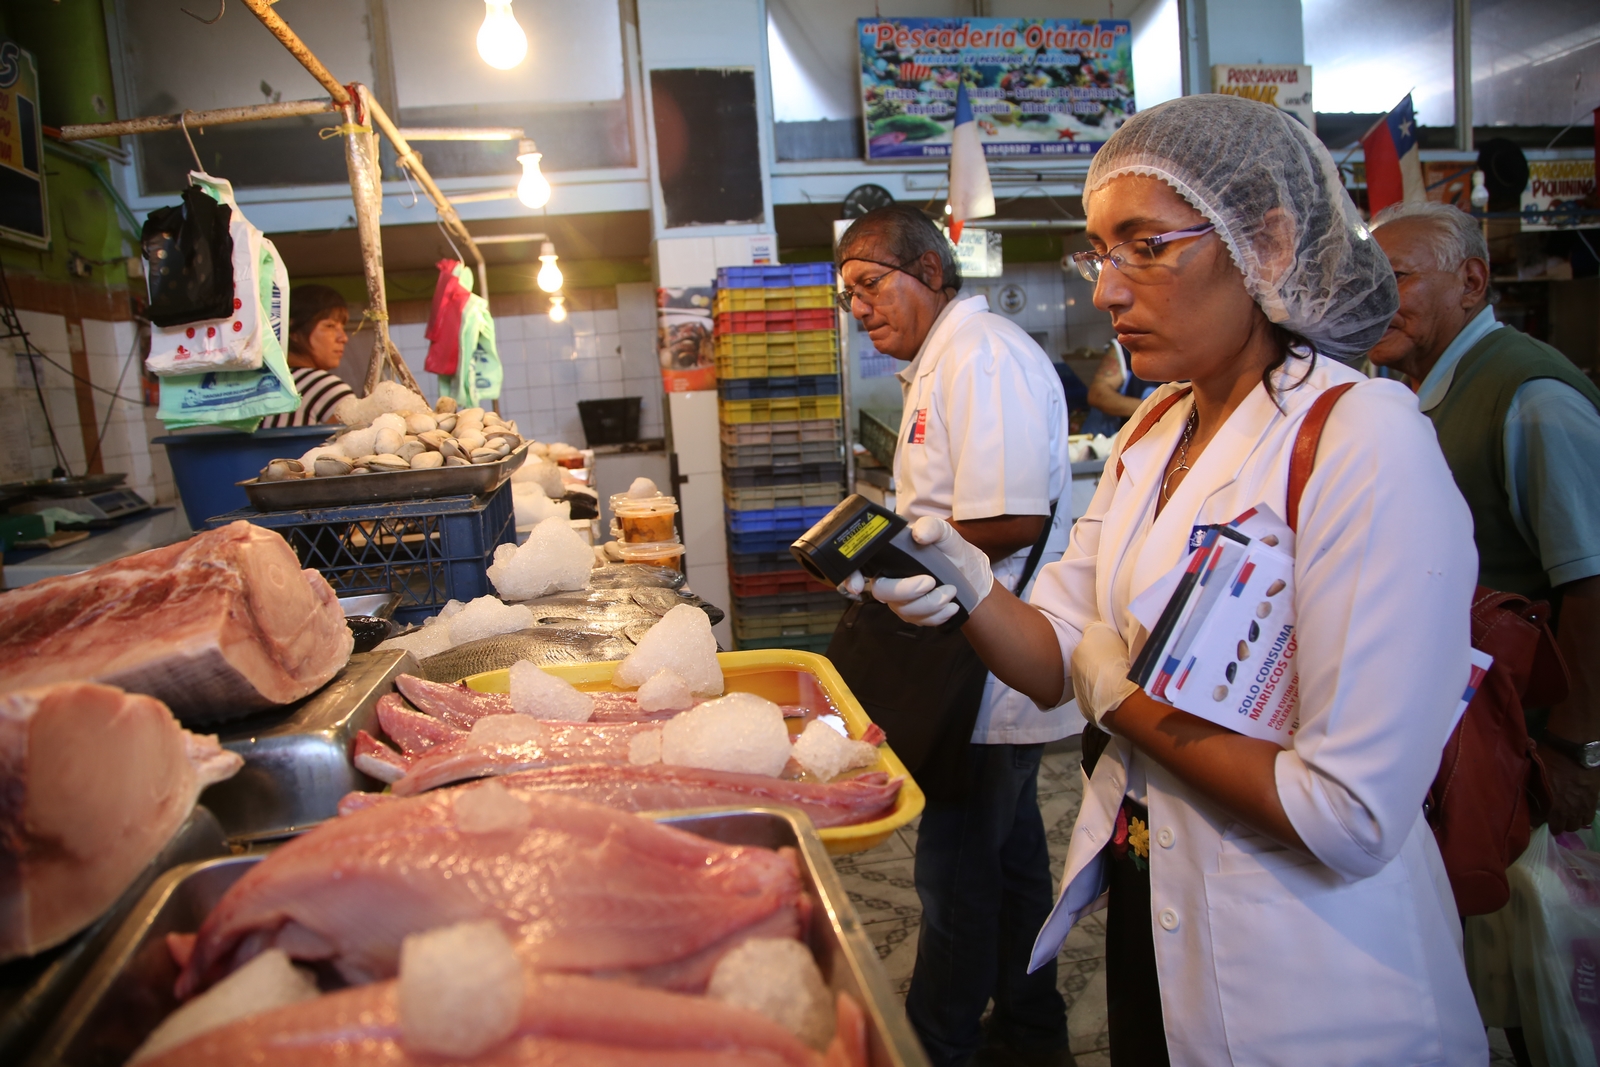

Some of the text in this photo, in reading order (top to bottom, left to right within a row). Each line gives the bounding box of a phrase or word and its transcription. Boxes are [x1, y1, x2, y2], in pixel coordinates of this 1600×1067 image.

[979, 54, 1023, 64] PESCADOS
[1239, 624, 1294, 716] SOLO CONSUMA
[1249, 632, 1298, 721] MARISCOS COC
[1267, 709, 1282, 728] PARA
[1278, 684, 1296, 710] EVITAR
